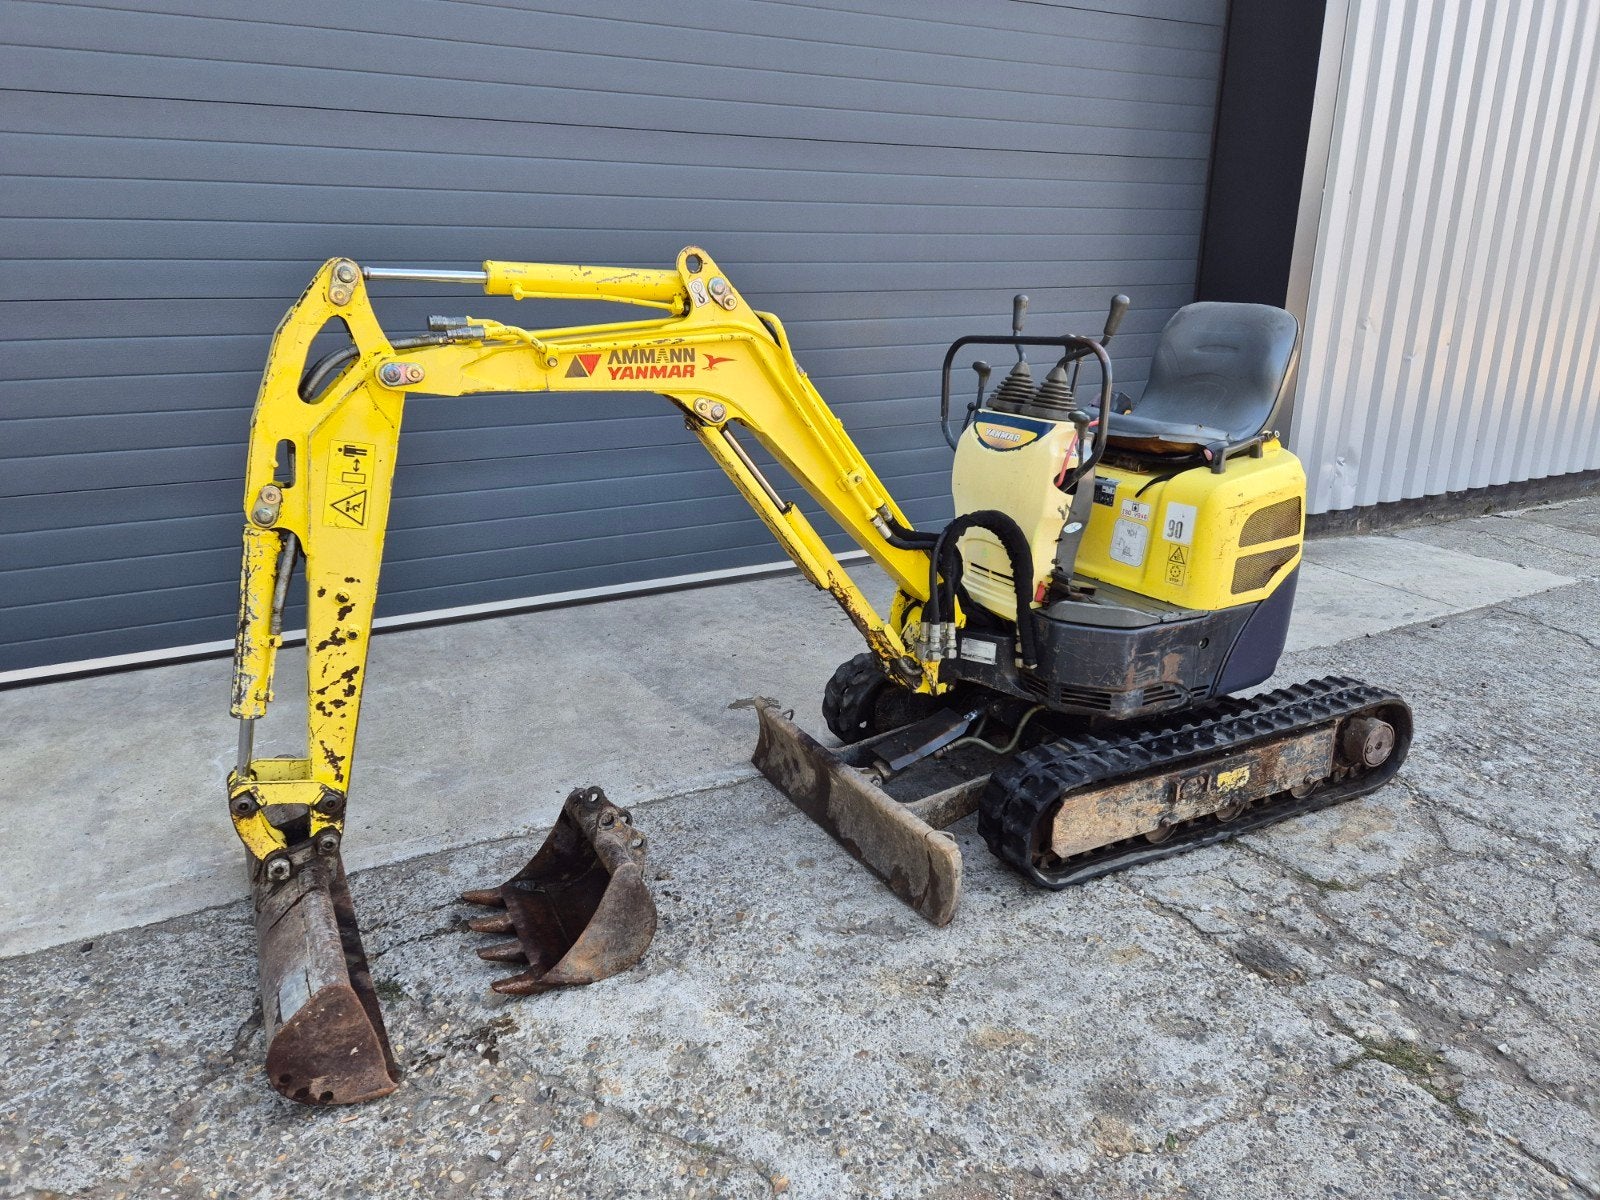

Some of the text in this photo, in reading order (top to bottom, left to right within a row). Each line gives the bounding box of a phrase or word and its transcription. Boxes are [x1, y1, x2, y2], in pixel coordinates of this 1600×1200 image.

[608, 348, 695, 364] AMMANN
[607, 365, 695, 380] YANMAR
[985, 427, 1021, 442] YANMAR
[1167, 519, 1183, 539] 90
